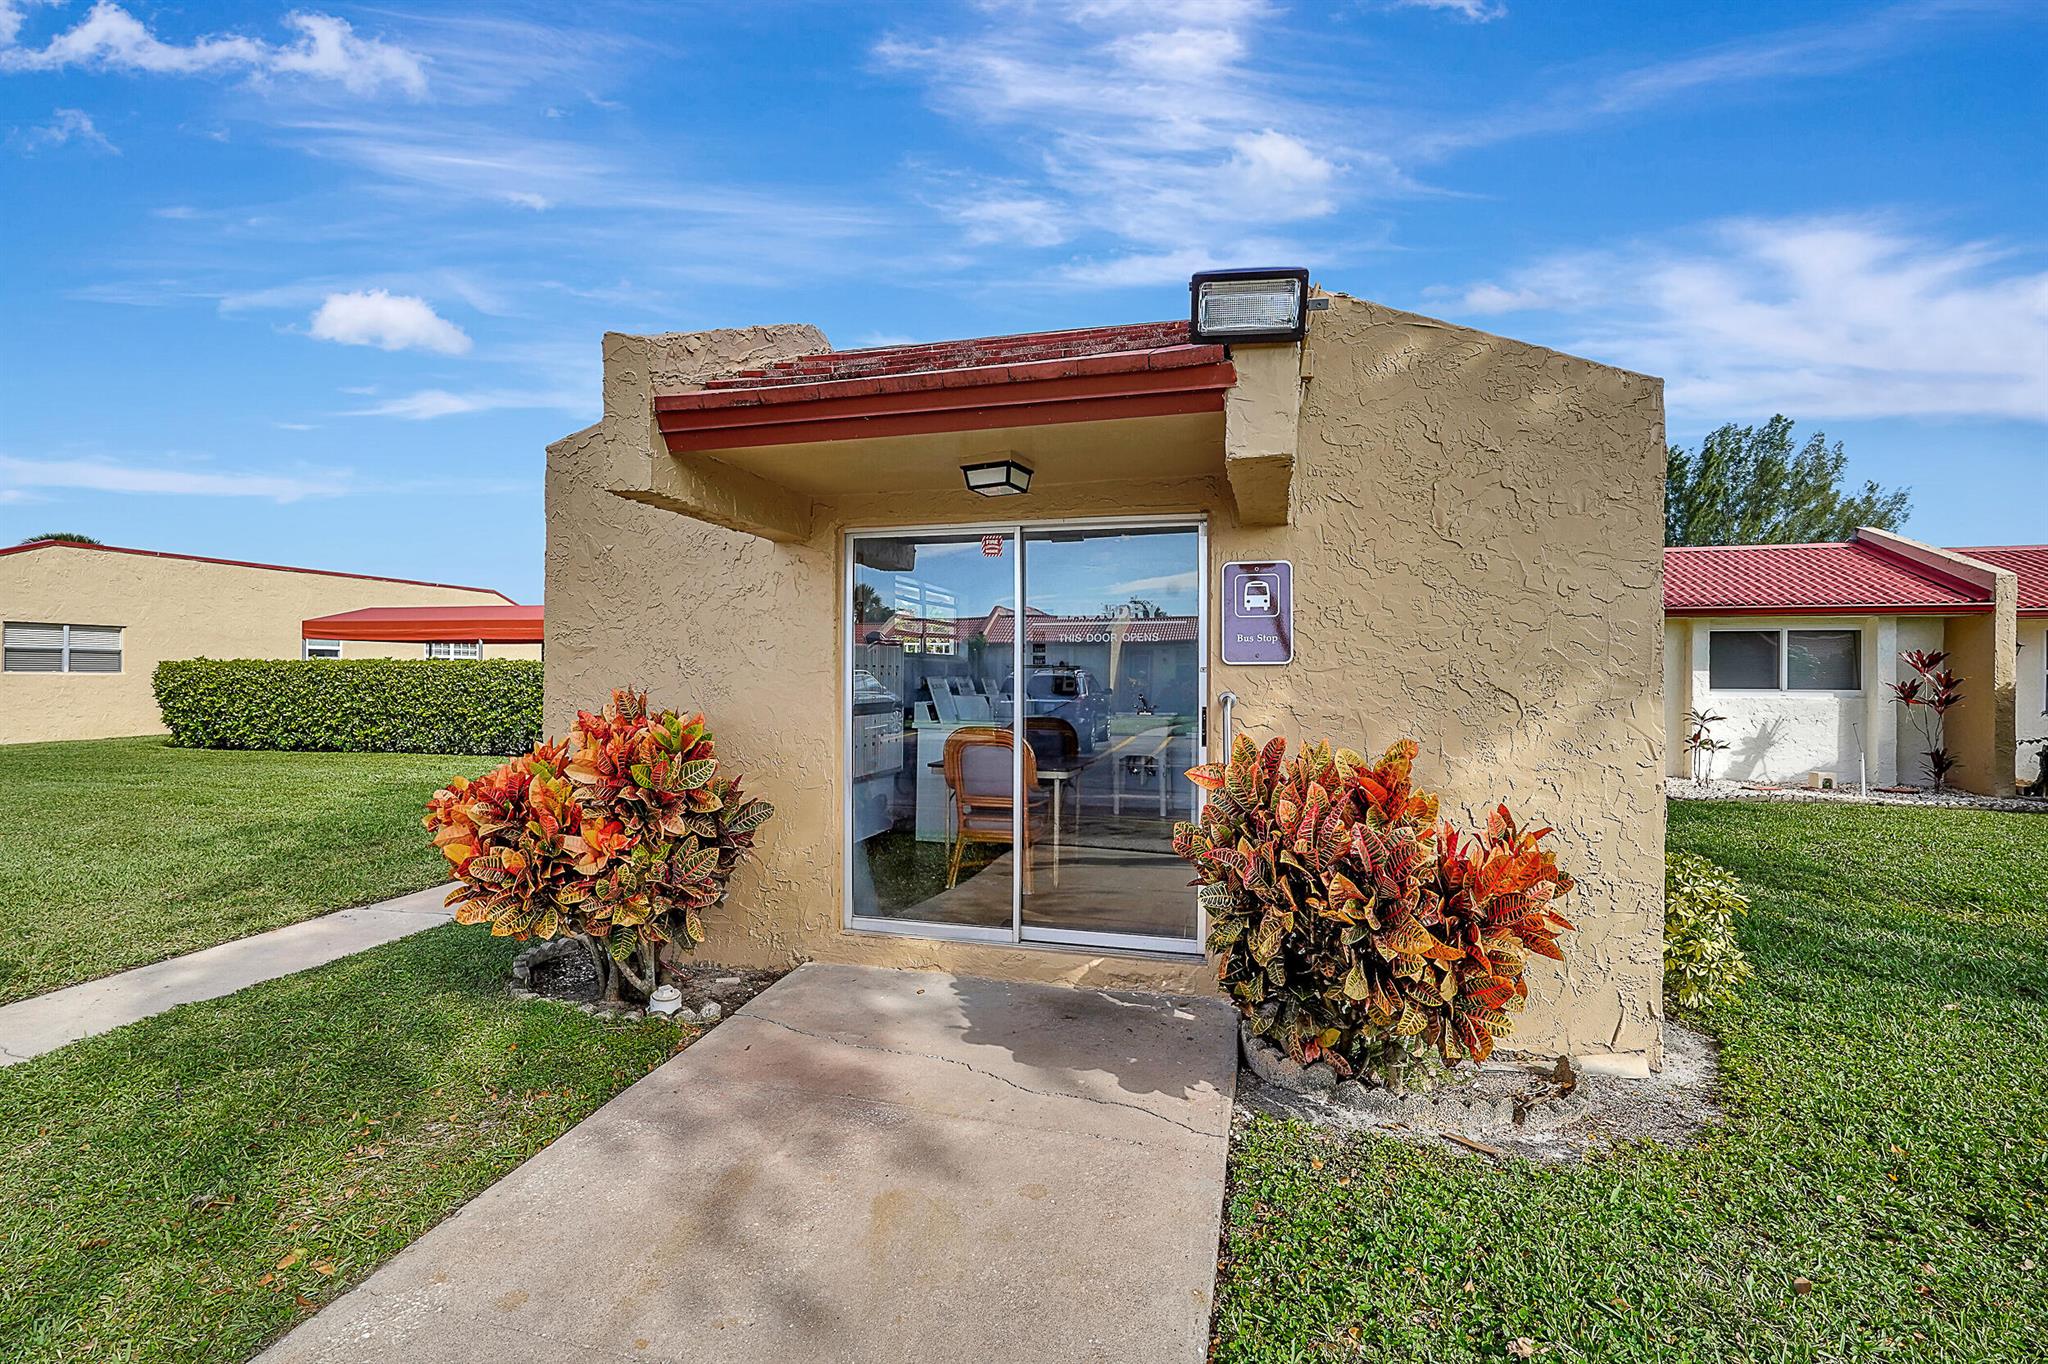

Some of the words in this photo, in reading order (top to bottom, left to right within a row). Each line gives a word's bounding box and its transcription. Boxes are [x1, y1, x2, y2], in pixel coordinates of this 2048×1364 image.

[1060, 633, 1082, 643] THIS
[1086, 633, 1117, 643] DOOR
[1122, 632, 1160, 642] OPENS
[1236, 633, 1254, 643] Bus
[1256, 633, 1278, 644] Stop
